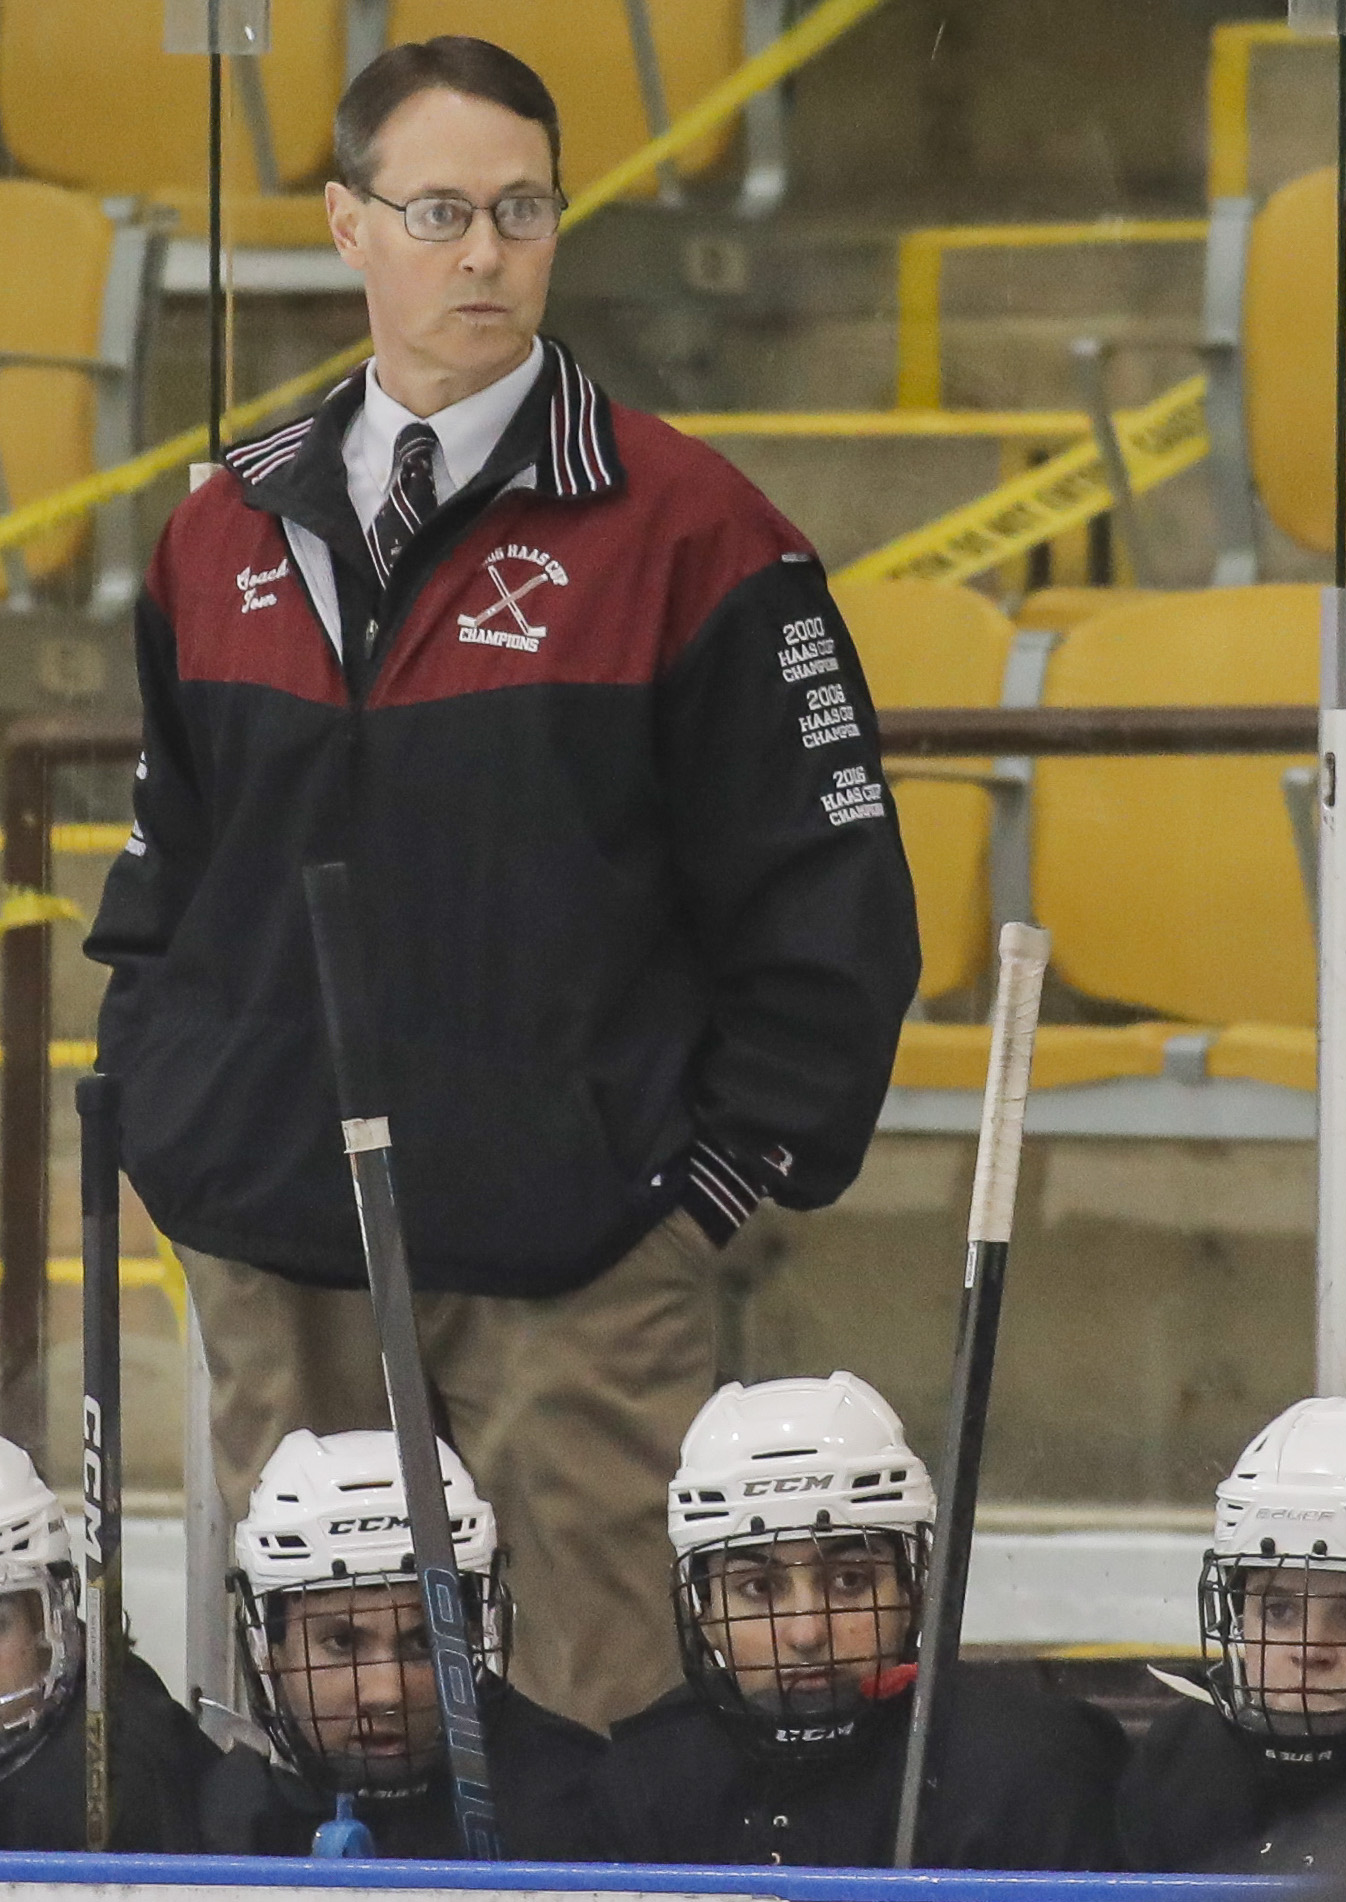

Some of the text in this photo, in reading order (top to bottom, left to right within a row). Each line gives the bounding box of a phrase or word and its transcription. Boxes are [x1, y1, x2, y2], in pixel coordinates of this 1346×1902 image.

[507, 544, 550, 567] HAAS
[459, 627, 539, 653] CHAMPIONS
[782, 616, 826, 646] 2000
[778, 642, 819, 668] HAAS
[798, 708, 841, 733] HAAS
[820, 786, 864, 812] HAAS
[84, 1394, 103, 1564] CCM
[742, 1474, 835, 1497] CCM
[328, 1515, 412, 1535] CCM
